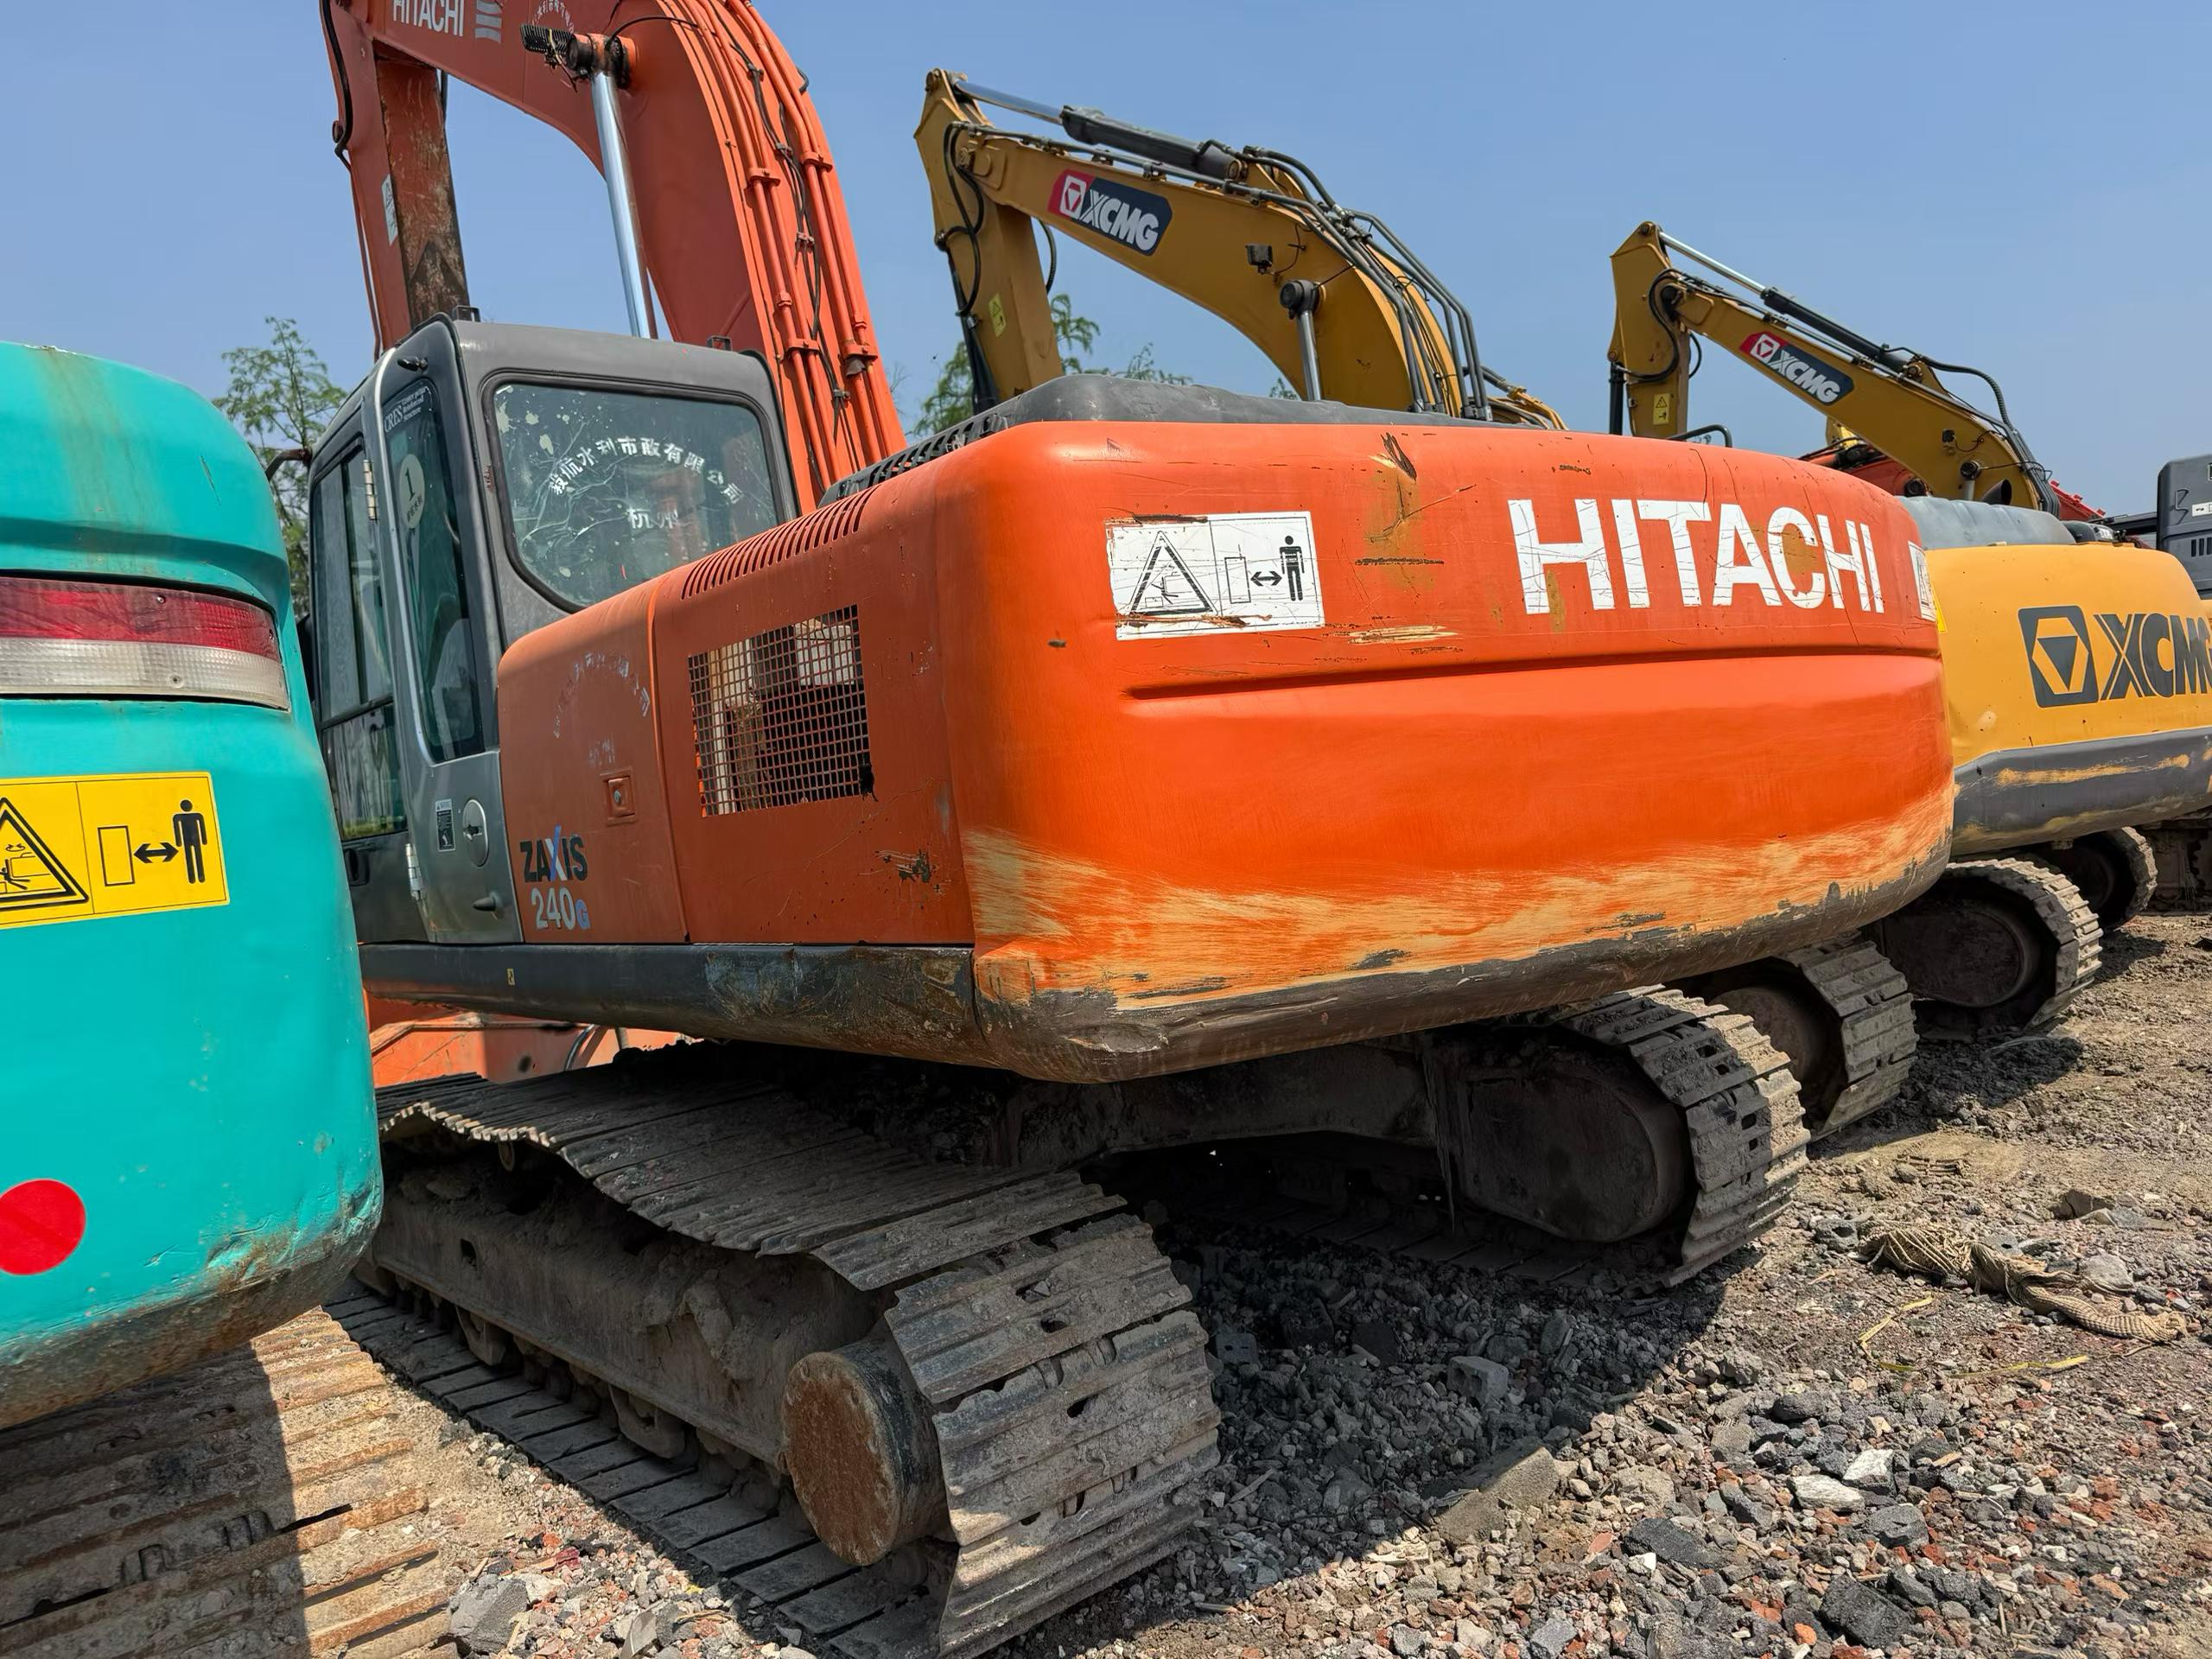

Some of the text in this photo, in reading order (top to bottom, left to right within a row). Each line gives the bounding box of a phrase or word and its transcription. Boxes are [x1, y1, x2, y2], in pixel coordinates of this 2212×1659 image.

[1079, 189, 1159, 251] XCMG
[1767, 349, 1840, 404] XCMG
[384, 404, 404, 433] CRES
[404, 467, 416, 501] 1
[1507, 499, 1885, 614] HITACHI
[519, 824, 588, 882] ZAXIS
[531, 887, 591, 931] 240G
